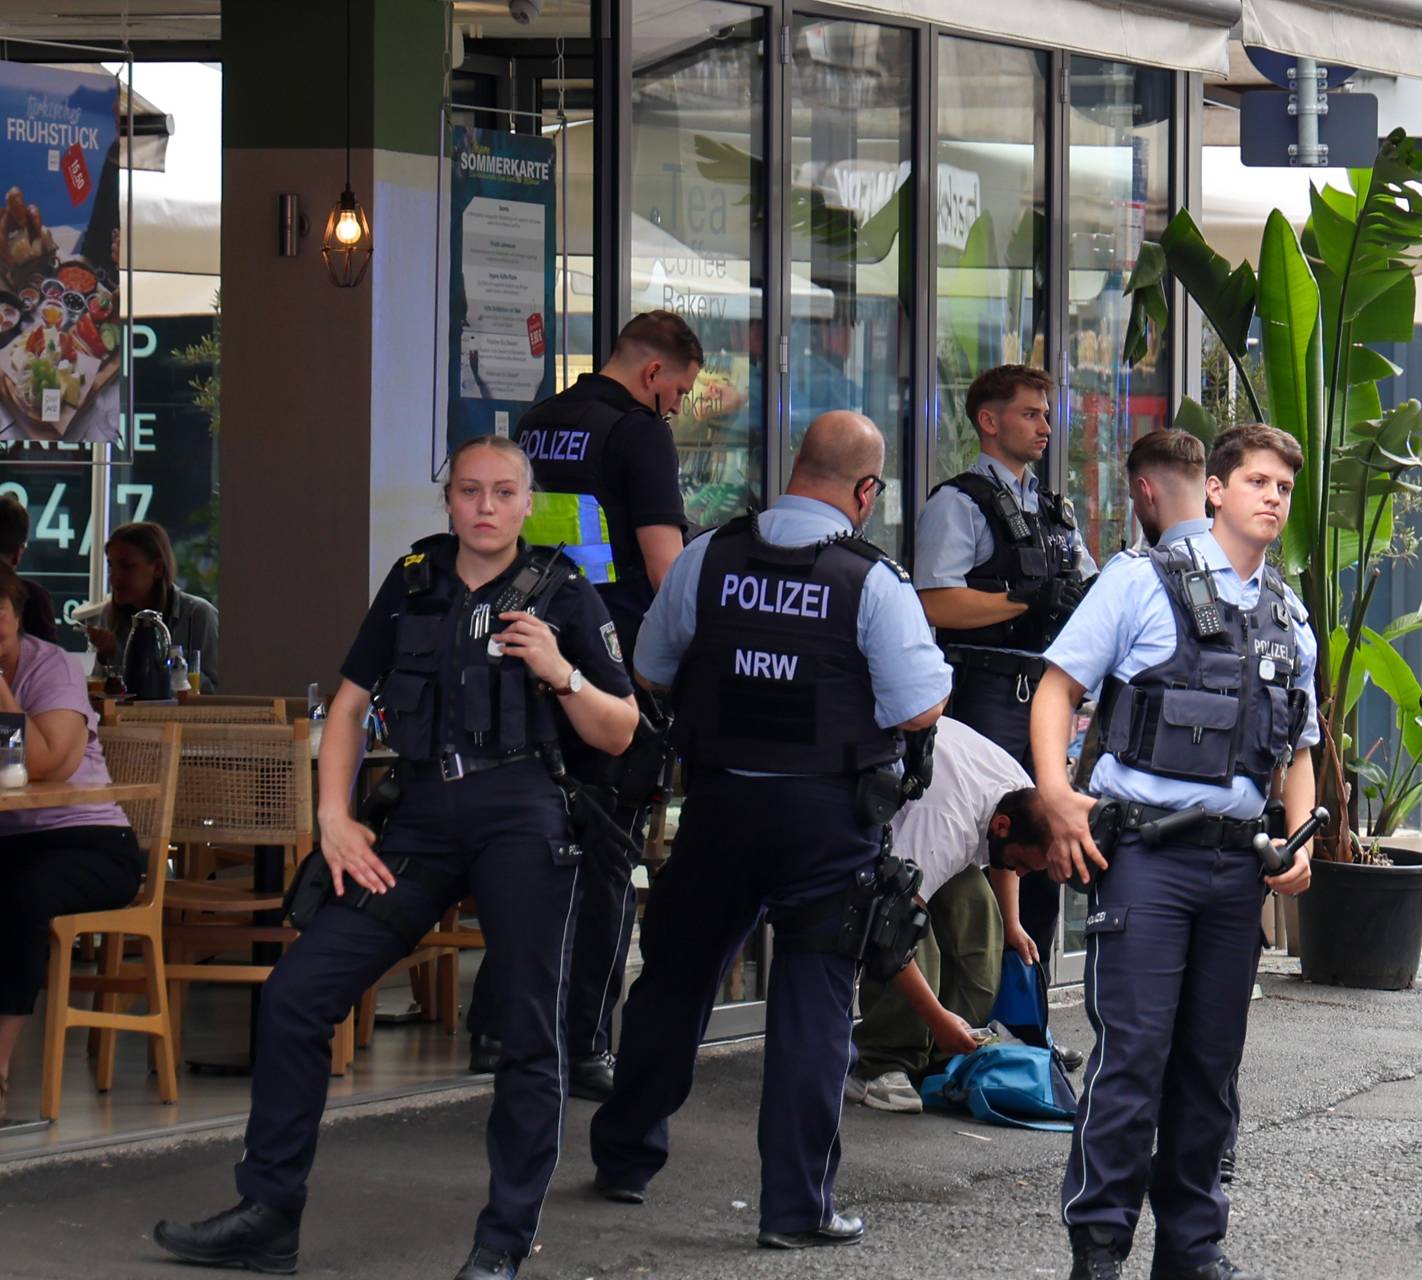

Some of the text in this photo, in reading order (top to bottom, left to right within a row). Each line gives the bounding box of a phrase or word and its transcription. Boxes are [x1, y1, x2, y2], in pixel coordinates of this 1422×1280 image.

[7, 115, 99, 150] FRÜHSTÜCK
[461, 152, 549, 180] SOMMERKARTE
[663, 163, 727, 236] Tea
[664, 285, 727, 320] Bakery
[682, 390, 723, 417] cktail
[518, 429, 590, 460] POLIZEI
[721, 574, 830, 618] POLIZEI
[735, 649, 798, 680] NRW
[1254, 638, 1288, 660] POLIZEI
